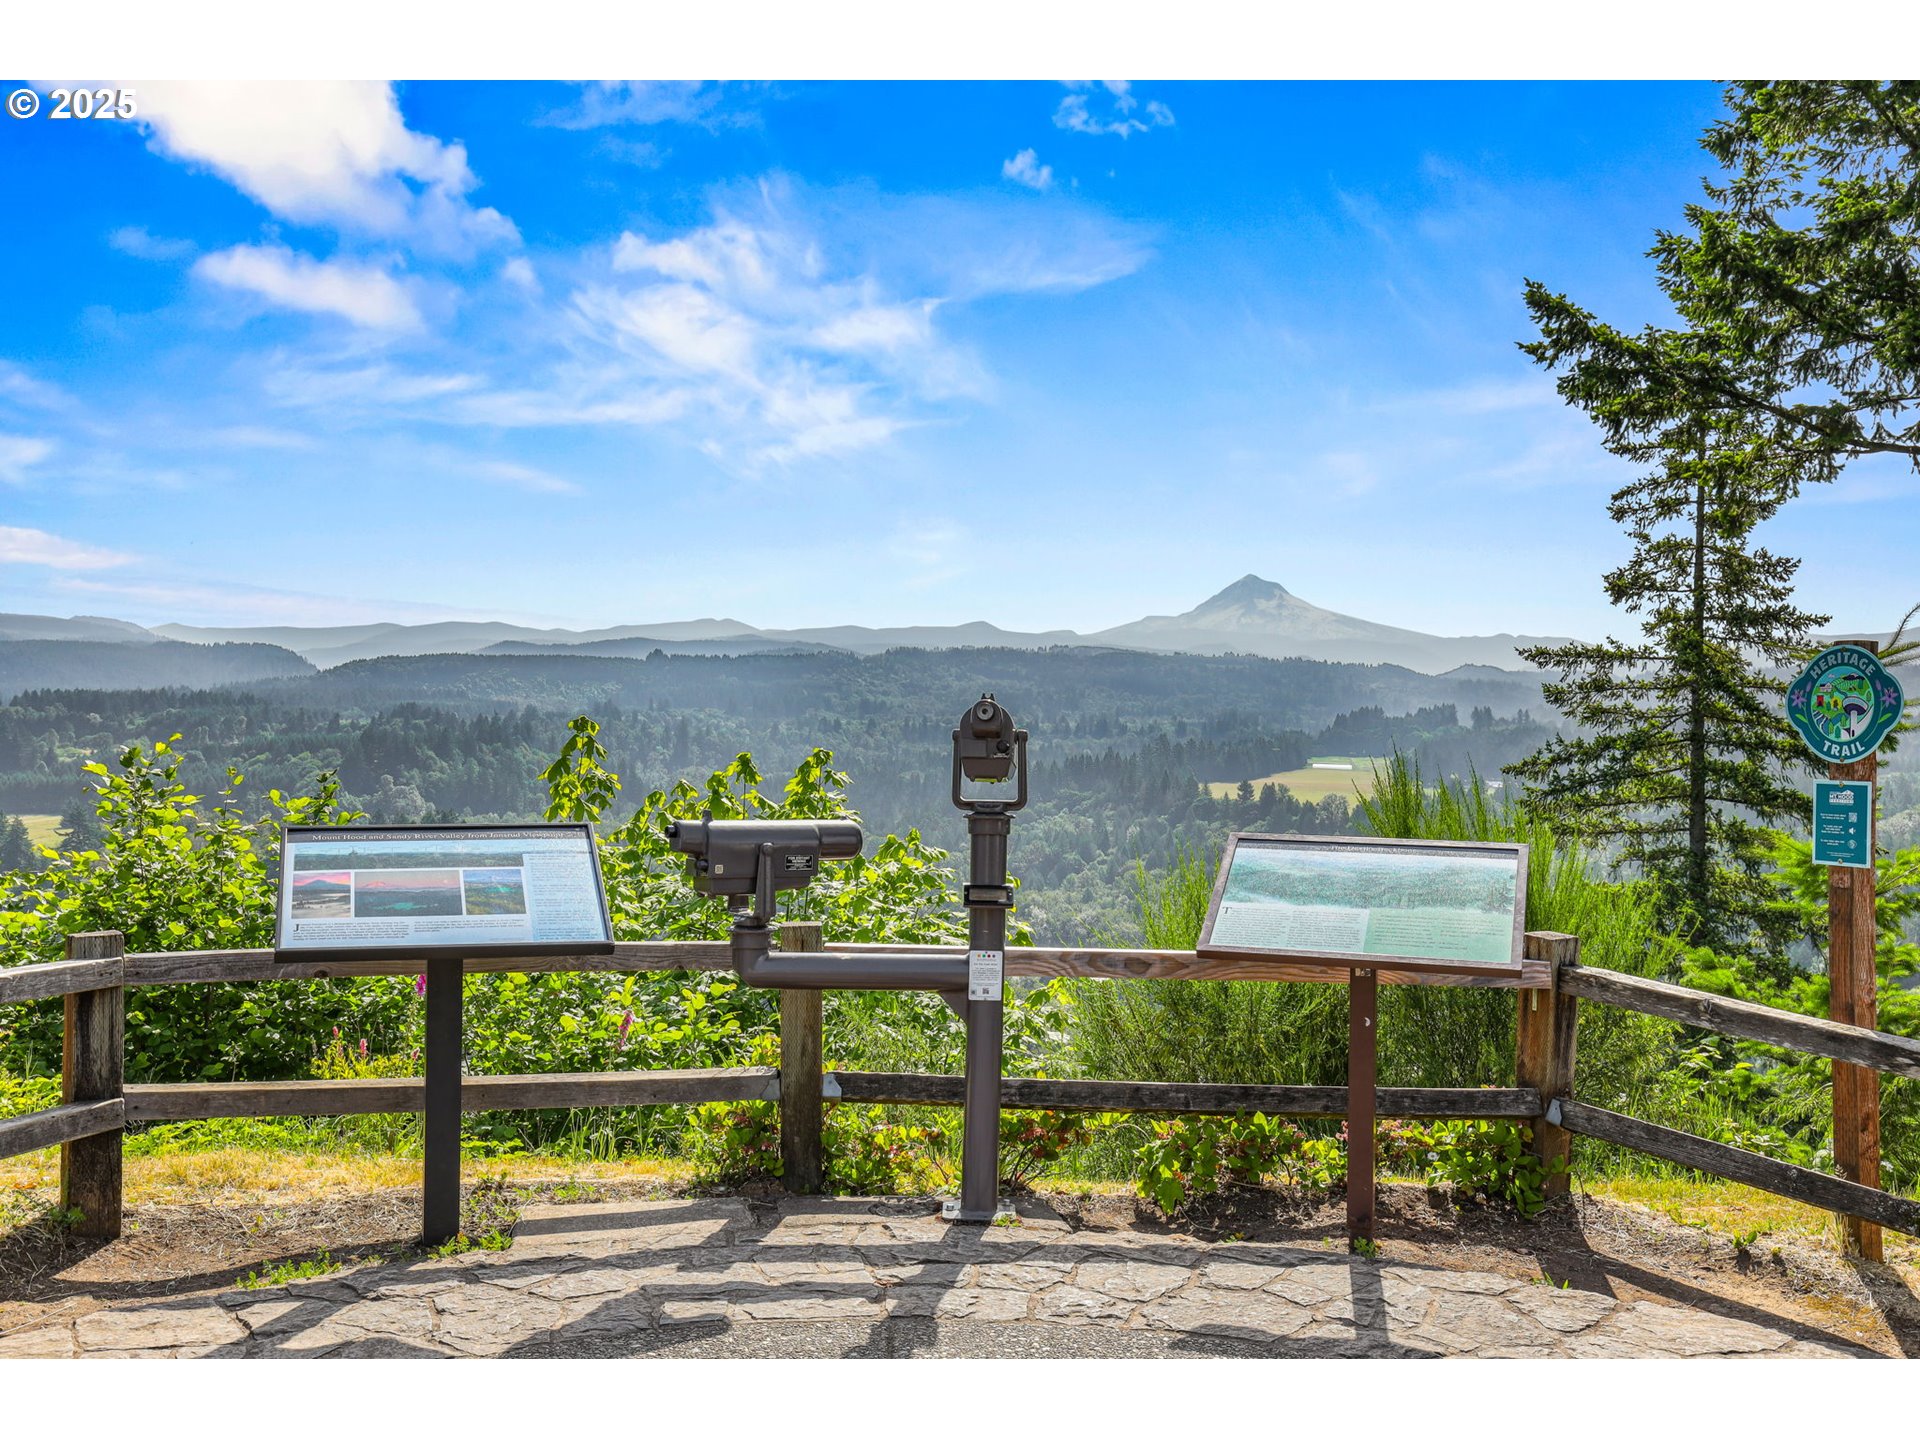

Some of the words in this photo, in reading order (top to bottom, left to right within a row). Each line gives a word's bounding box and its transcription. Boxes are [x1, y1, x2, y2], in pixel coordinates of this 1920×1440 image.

[1809, 651, 1876, 680] HERITAGE
[1822, 740, 1865, 757] TRAIL
[312, 833, 341, 841] Mount
[343, 833, 367, 841] Hood
[386, 833, 412, 841] Sandy
[440, 832, 465, 840] Valley
